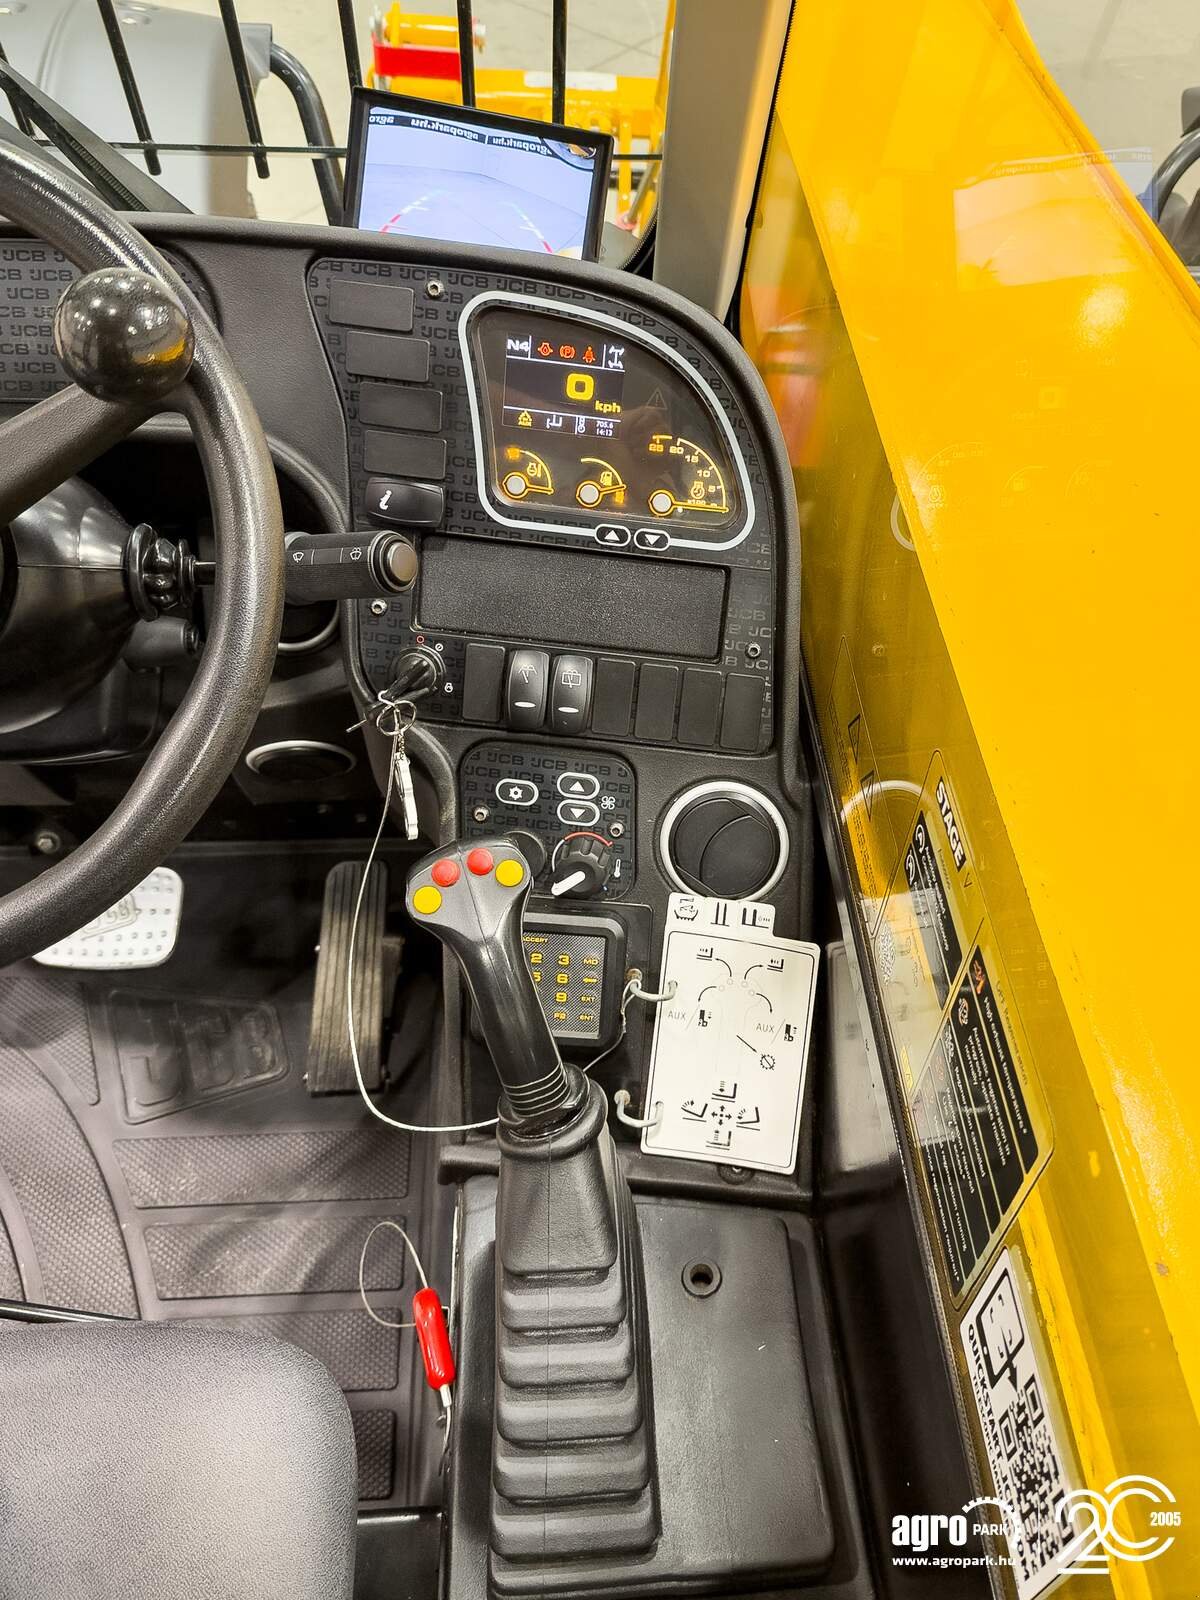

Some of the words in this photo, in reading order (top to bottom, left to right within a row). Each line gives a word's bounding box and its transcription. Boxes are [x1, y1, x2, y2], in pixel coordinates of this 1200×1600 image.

[3, 249, 47, 262] JCB
[29, 269, 73, 281] JCB
[351, 263, 392, 277] JCB
[448, 273, 489, 289] JCB
[496, 278, 538, 294] JCB
[7, 287, 50, 300] JCB
[14, 362, 57, 374] JCB
[566, 373, 595, 401] 0
[595, 400, 621, 413] kph
[669, 446, 684, 455] 20
[697, 469, 711, 478] 10
[464, 766, 500, 778] JCB
[487, 752, 524, 765] JCB
[531, 757, 568, 770] JCB
[574, 762, 611, 776] JCB
[935, 780, 964, 867] STAGE
[530, 952, 543, 964] 2
[558, 954, 570, 966] 3
[557, 973, 569, 985] 6
[667, 1010, 687, 1022] AUX
[756, 1022, 775, 1034] AUX
[983, 995, 993, 1024] High
[991, 1020, 1005, 1062] exhaust
[972, 1024, 989, 1078] Automatic
[985, 1076, 1007, 1146] regeneration
[991, 1120, 1006, 1167] machine
[970, 1129, 985, 1179] cancelled
[954, 1210, 967, 1252] running
